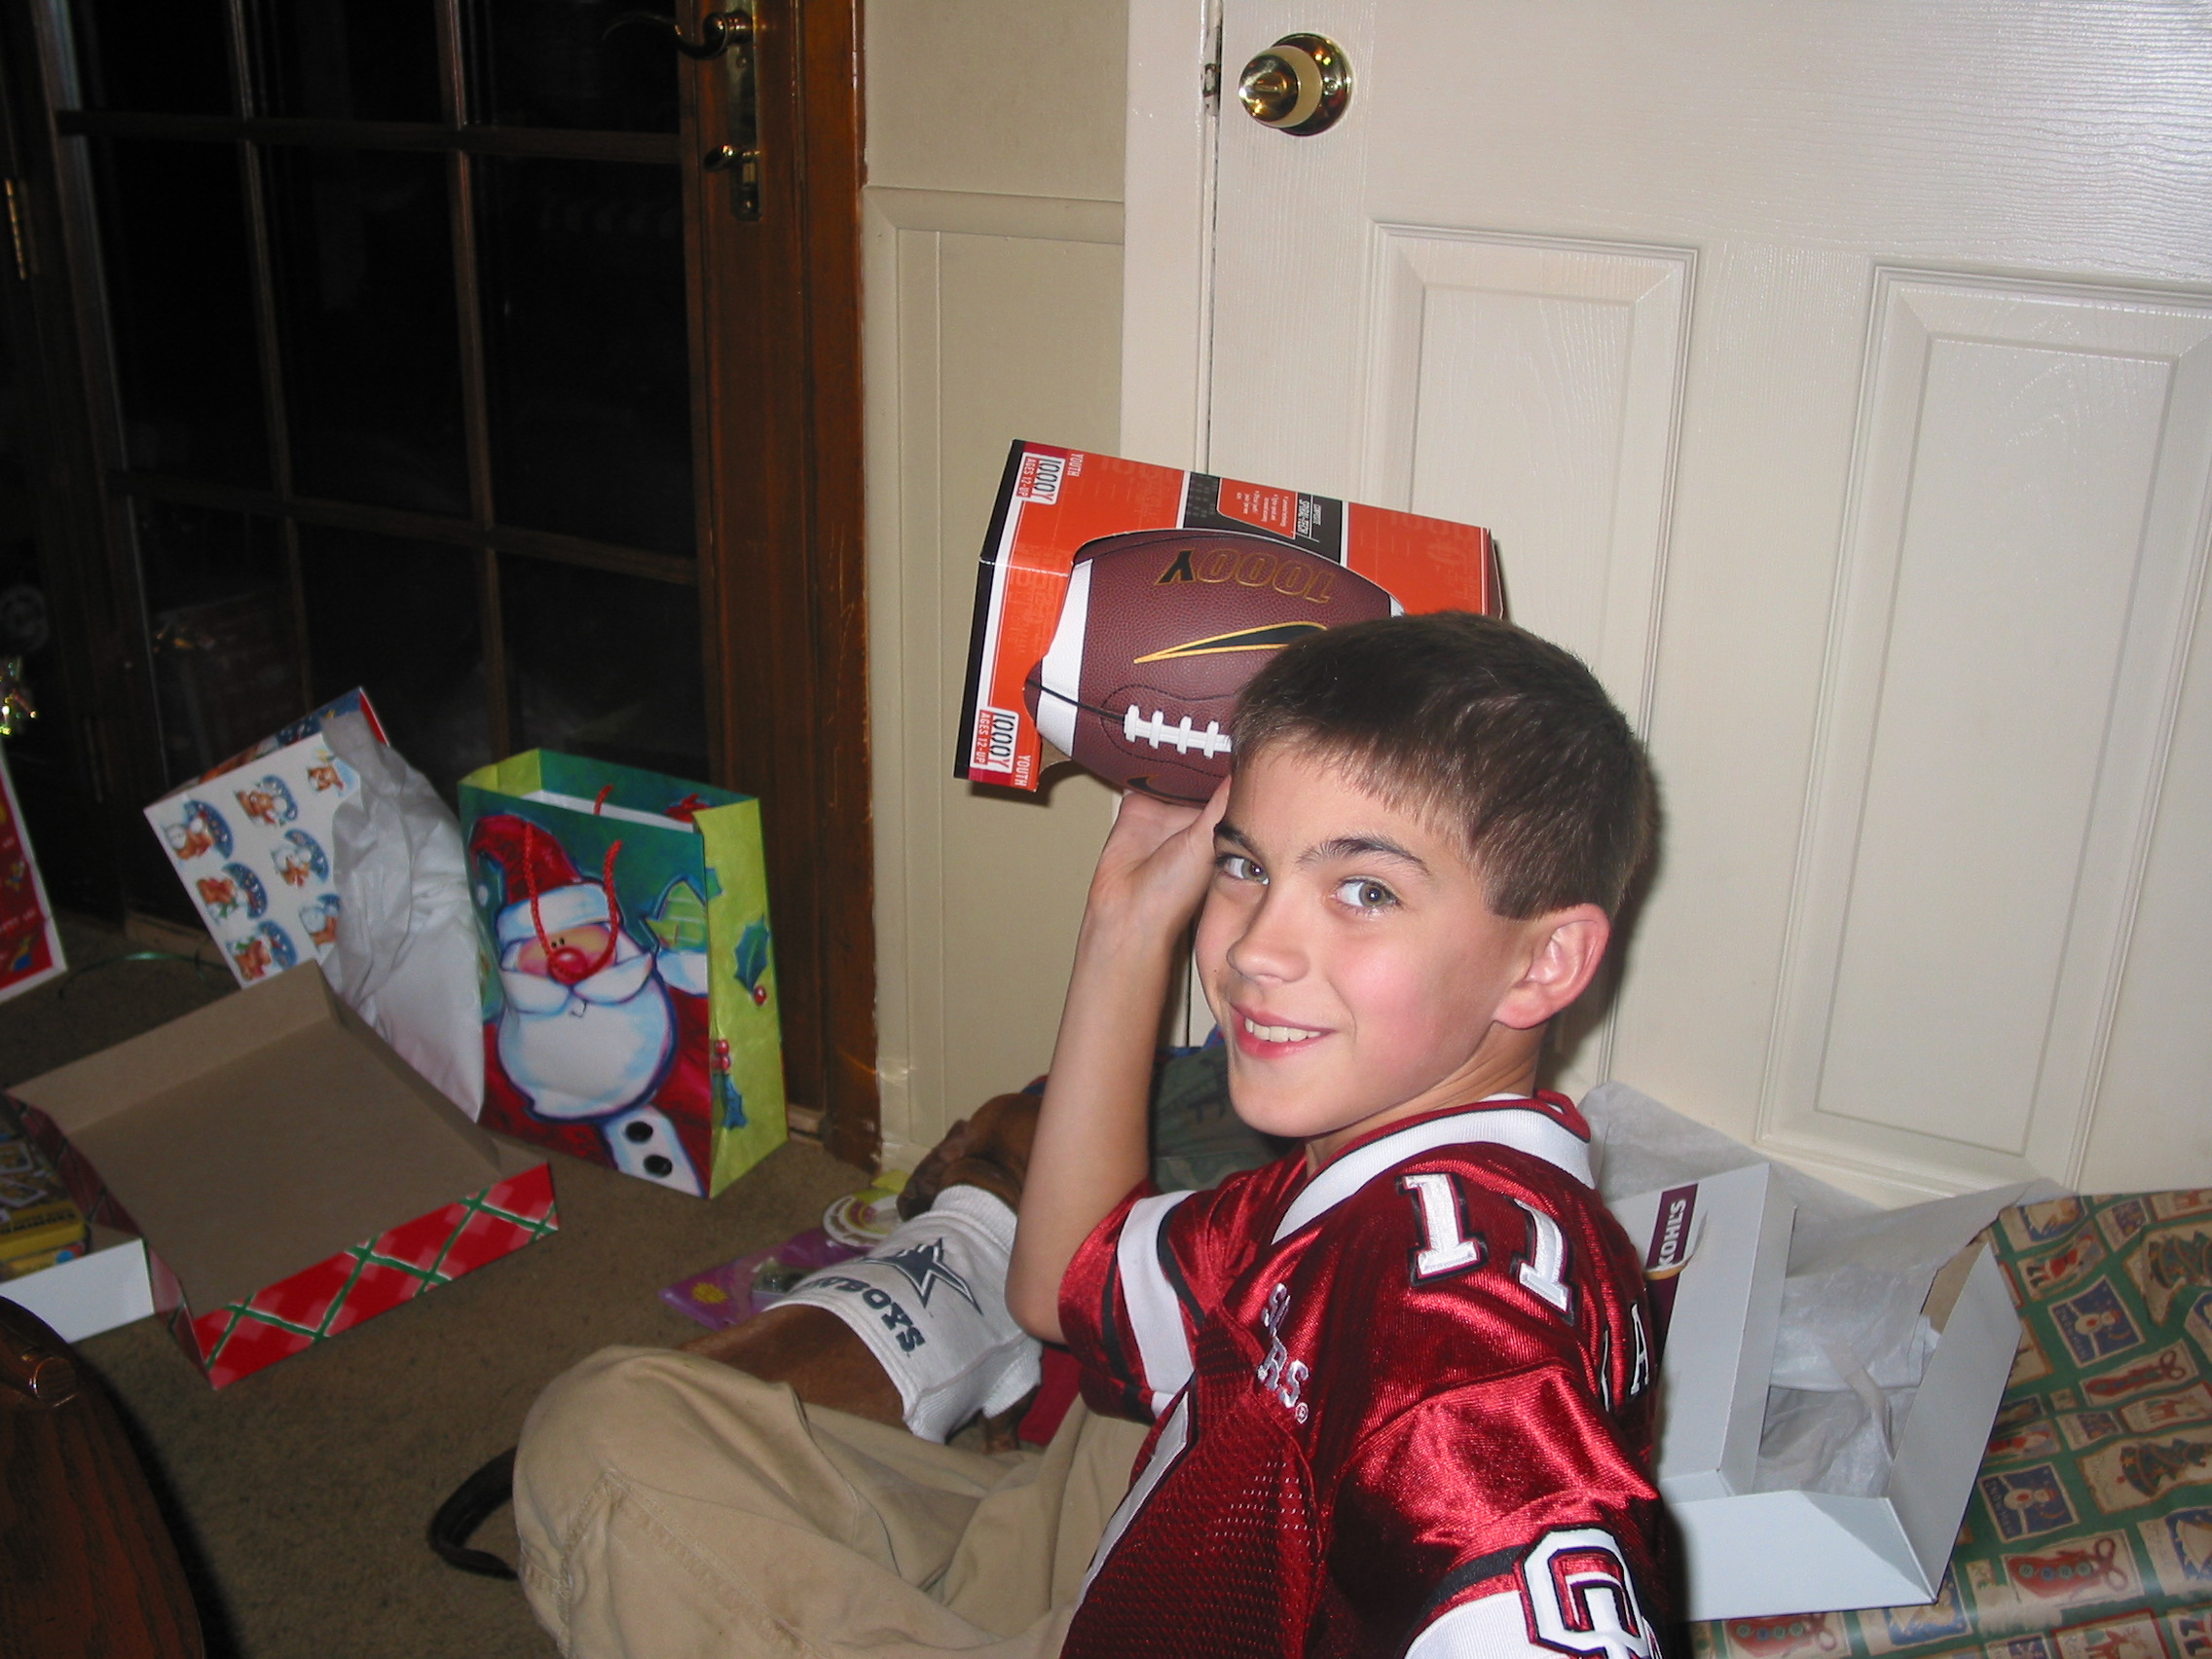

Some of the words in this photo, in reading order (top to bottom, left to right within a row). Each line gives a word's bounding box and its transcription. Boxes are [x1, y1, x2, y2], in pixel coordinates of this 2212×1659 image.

[1022, 457, 1037, 476] AGES
[1031, 458, 1063, 501] 1000Y
[1066, 453, 1085, 477] YOUTH
[1154, 548, 1337, 605] 1000Y
[978, 711, 992, 736] AGES
[975, 736, 989, 764] 12-UP
[988, 712, 1016, 769] 1000Y
[1014, 755, 1032, 787] YOUTH
